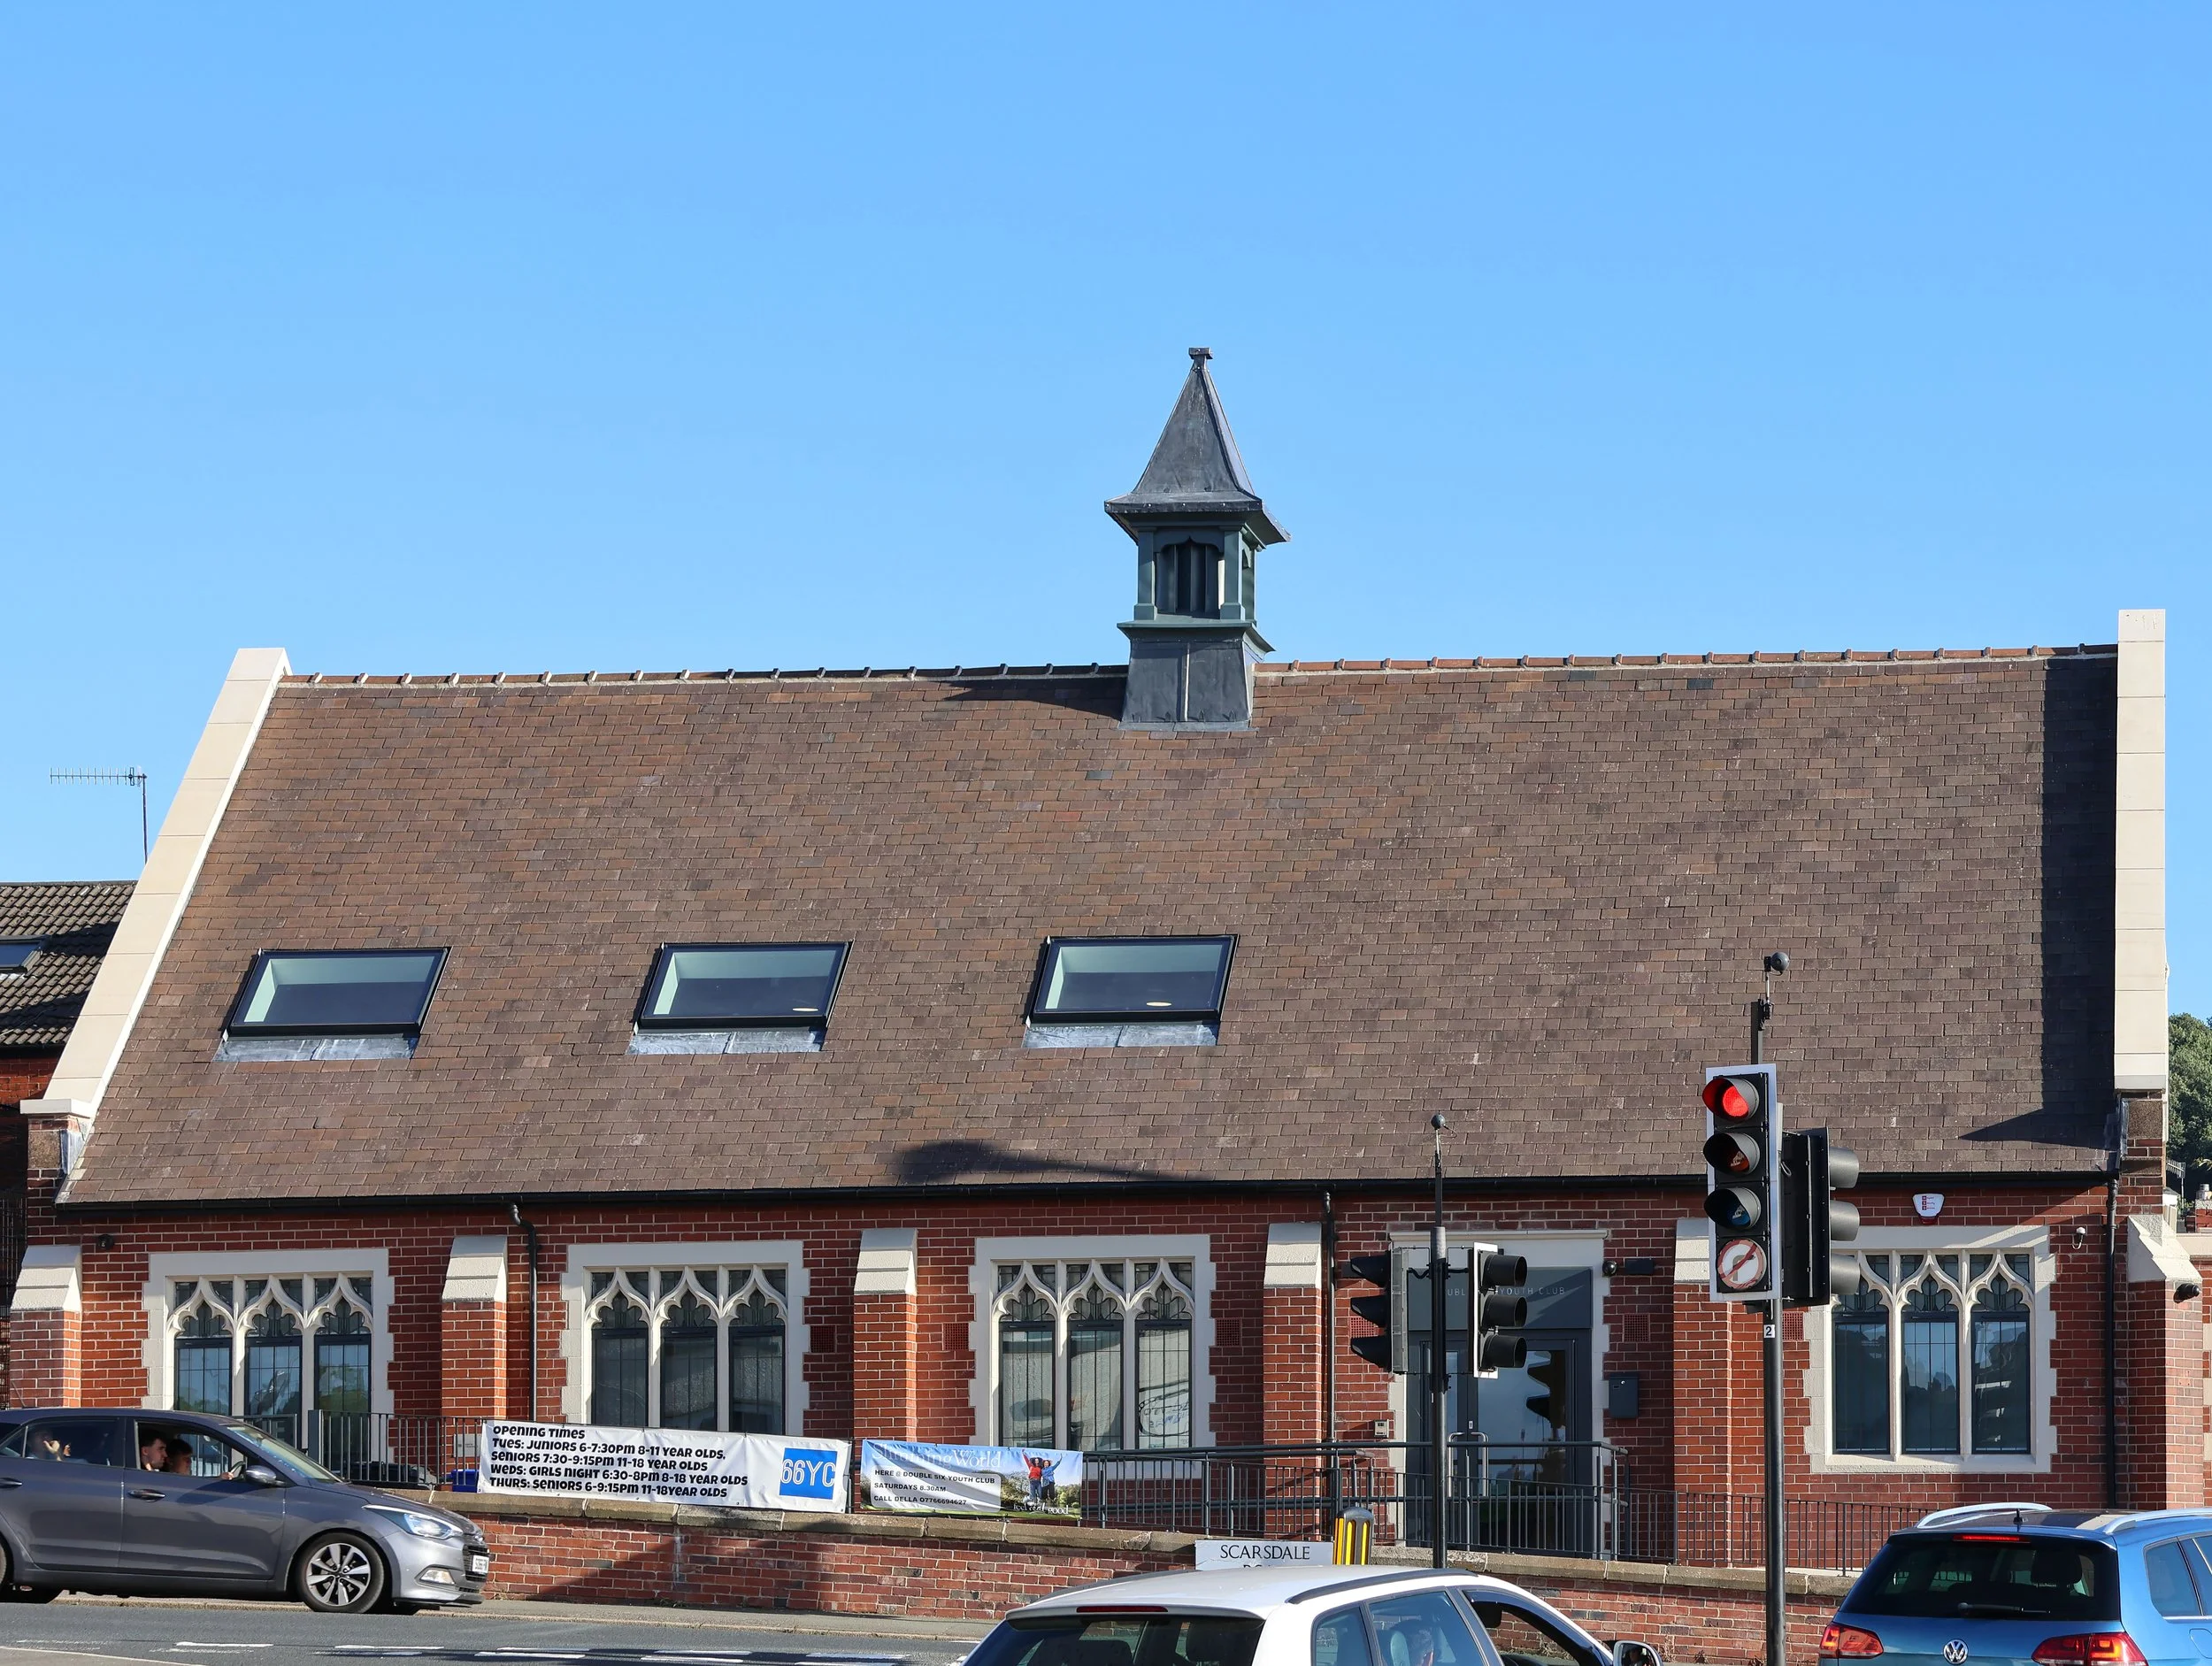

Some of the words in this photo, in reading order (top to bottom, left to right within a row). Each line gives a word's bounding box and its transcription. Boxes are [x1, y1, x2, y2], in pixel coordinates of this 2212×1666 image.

[1539, 1286, 1565, 1295] CLUB
[1766, 1326, 1772, 1336] 2
[638, 1445, 660, 1455] 8-11
[617, 1457, 645, 1468] 11-18
[679, 1461, 708, 1471] OLDS
[529, 1466, 561, 1477] GIRLS
[661, 1473, 687, 1483] 8-18
[720, 1475, 748, 1486] OLDS
[781, 1459, 836, 1487] 66YC
[490, 1477, 530, 1488] THURS:
[699, 1487, 727, 1497] OLDS
[1048, 1505, 1068, 1514] good
[1220, 1544, 1310, 1560] SCARSDALE
